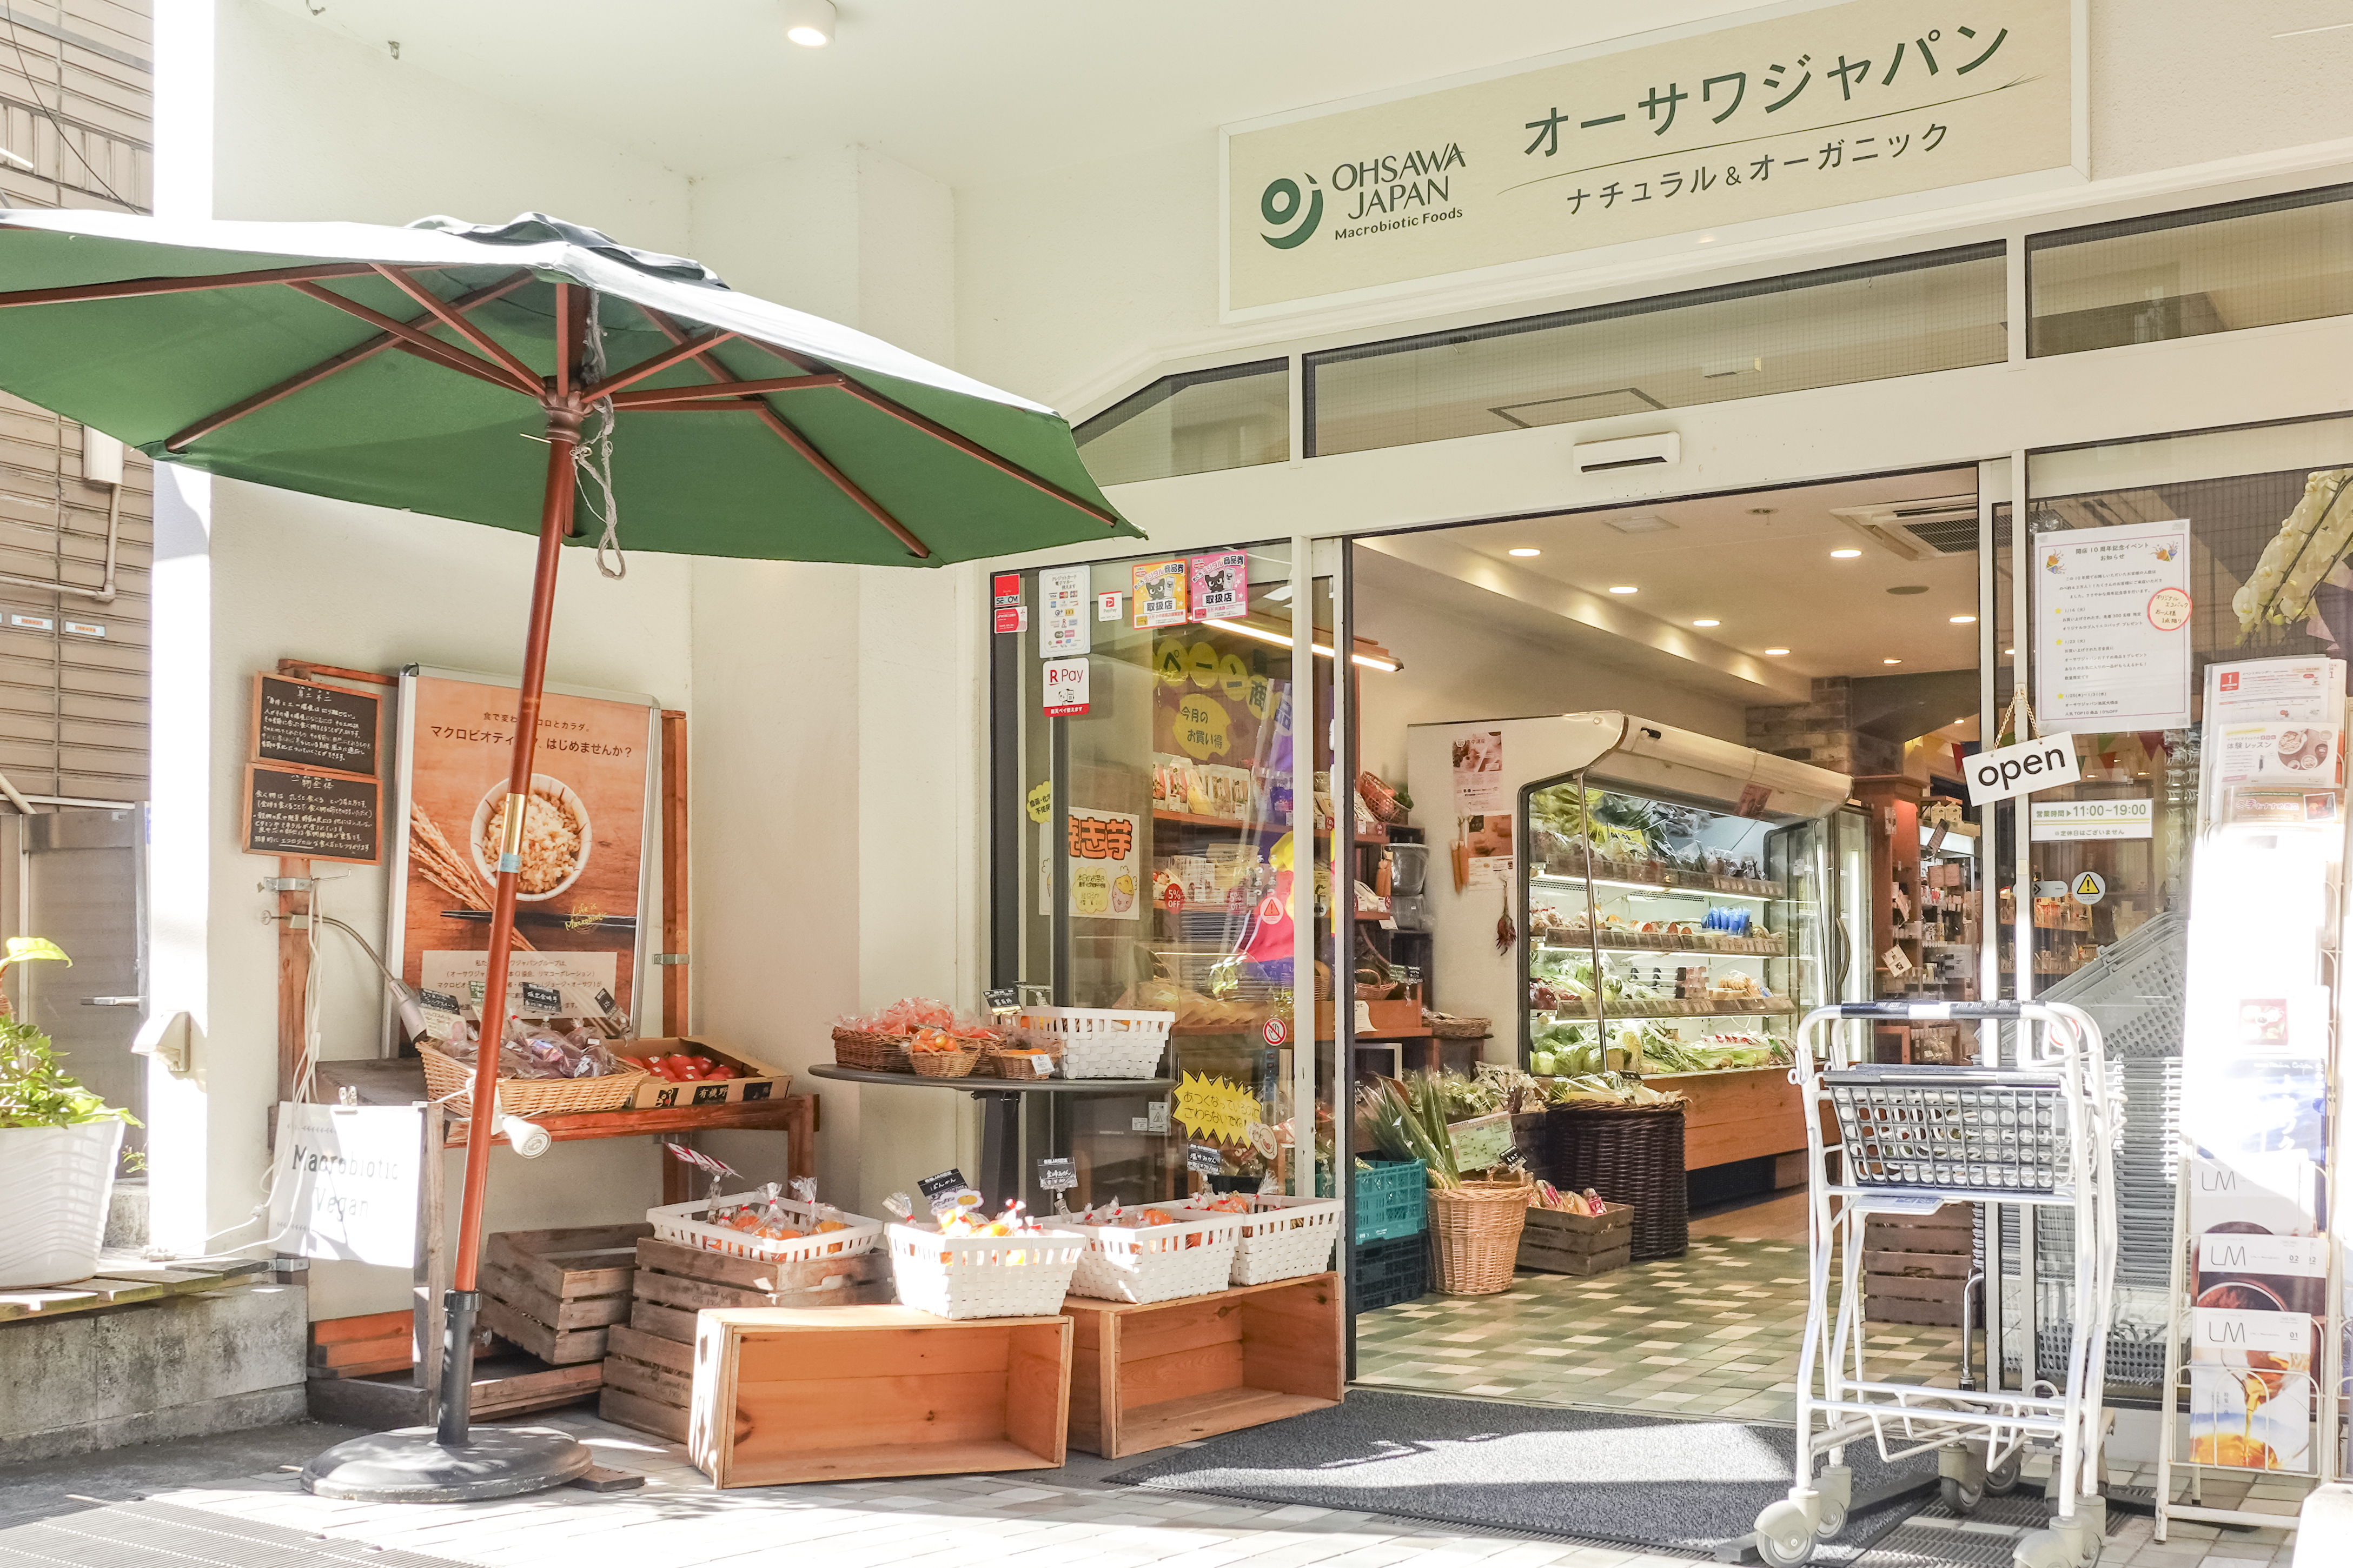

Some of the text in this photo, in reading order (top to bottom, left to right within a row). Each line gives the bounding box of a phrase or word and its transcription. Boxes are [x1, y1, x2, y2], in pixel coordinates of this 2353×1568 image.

[1523, 25, 2009, 157] オーサワジャパン
[1332, 142, 1466, 191] OHSAWA
[1348, 176, 1448, 220] JAPAN
[1335, 207, 1463, 240] Macrobiotic Foods
[996, 595, 1018, 604] SECOM
[1146, 600, 1172, 612] 取扱店
[1206, 593, 1232, 604] 取扱店
[1050, 669, 1083, 683] R Pay
[2228, 674, 2232, 683] 1
[483, 712, 589, 732] 食で変わコロとカラダ。
[1182, 706, 1208, 723] 今月の
[431, 725, 632, 758] マクロビオティ、はじめませんか？
[1187, 729, 1223, 749] お買い得
[1978, 748, 2066, 790] open
[2036, 810, 2065, 818] 営業時間
[2236, 799, 2299, 810] 冬季おすすめ商品
[1168, 889, 1181, 900] 5%
[1230, 892, 1242, 902] 5%
[572, 902, 597, 916] Life is
[1231, 902, 1243, 911] OFF
[565, 911, 608, 931] Macrobiotic
[292, 1144, 399, 1180] Macrobiotic
[2202, 1171, 2236, 1191] LM
[314, 1186, 368, 1222] Vegan
[2211, 1245, 2246, 1266] LM
[2209, 1320, 2245, 1344] LM
